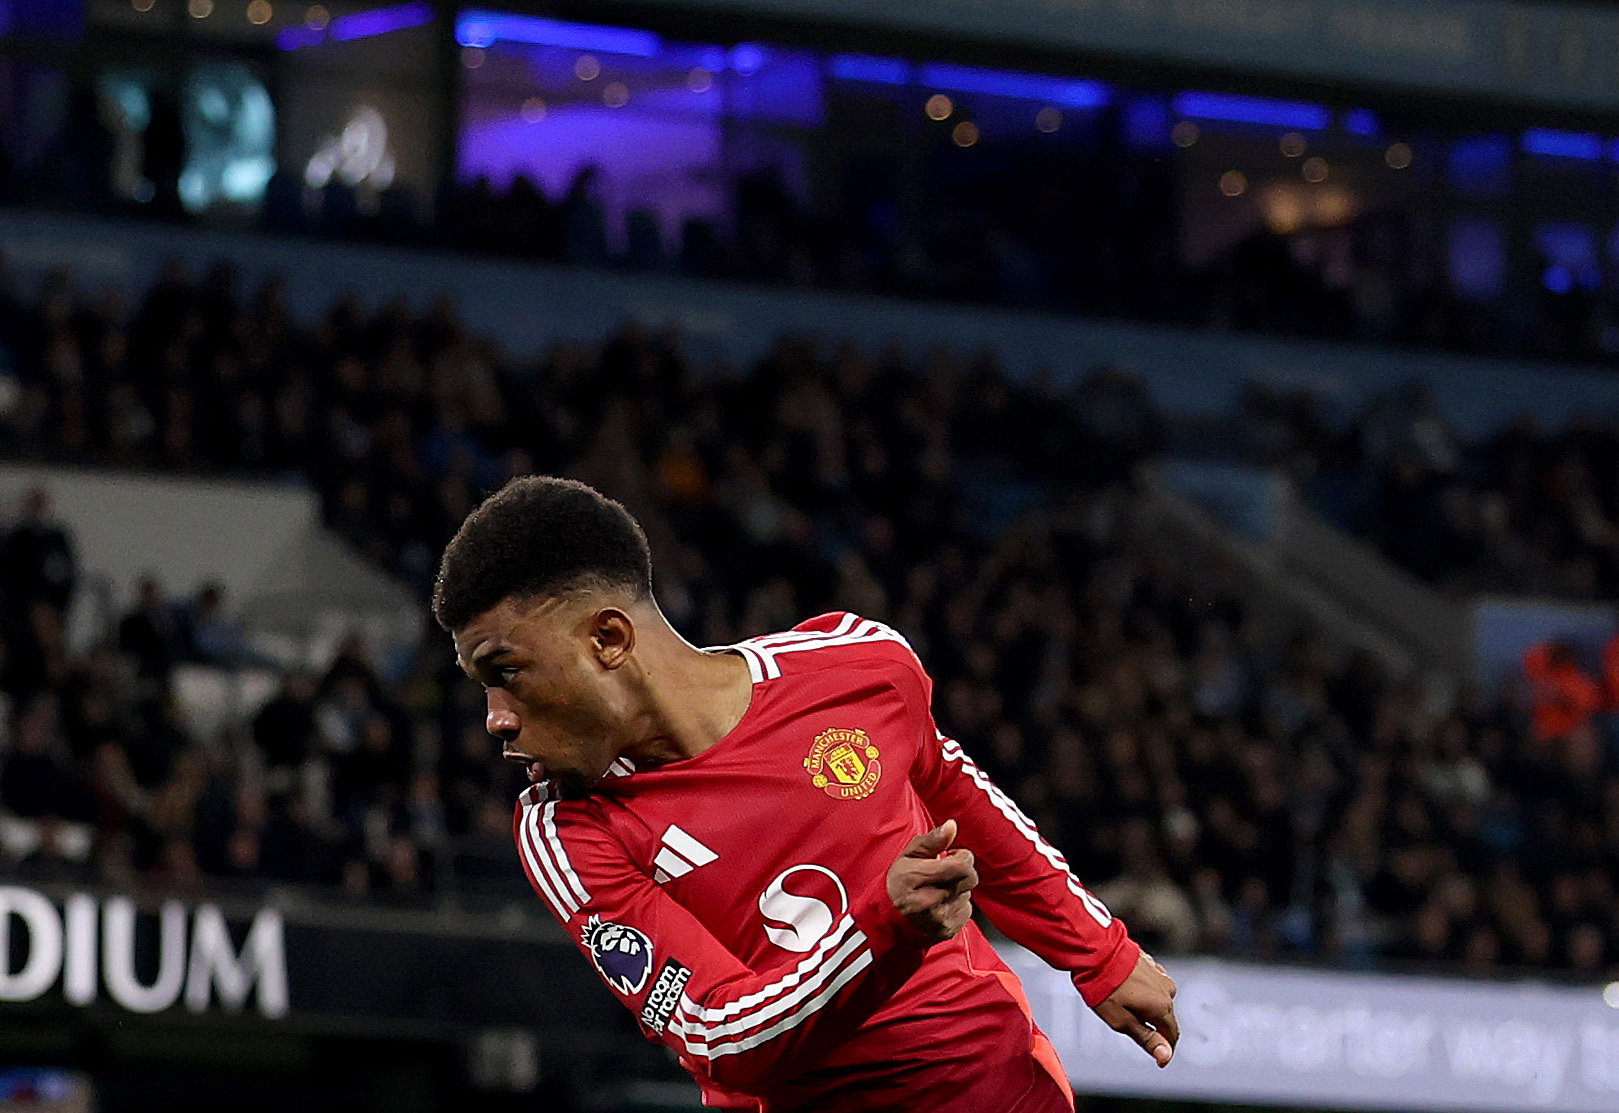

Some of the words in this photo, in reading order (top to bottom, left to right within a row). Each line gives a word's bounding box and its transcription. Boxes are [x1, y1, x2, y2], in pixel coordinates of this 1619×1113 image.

[811, 732, 864, 769] MANCHESTER
[841, 772, 877, 797] UNITED
[647, 964, 678, 1009] room
[657, 966, 692, 1018] racism
[1443, 1017, 1574, 1104] way
